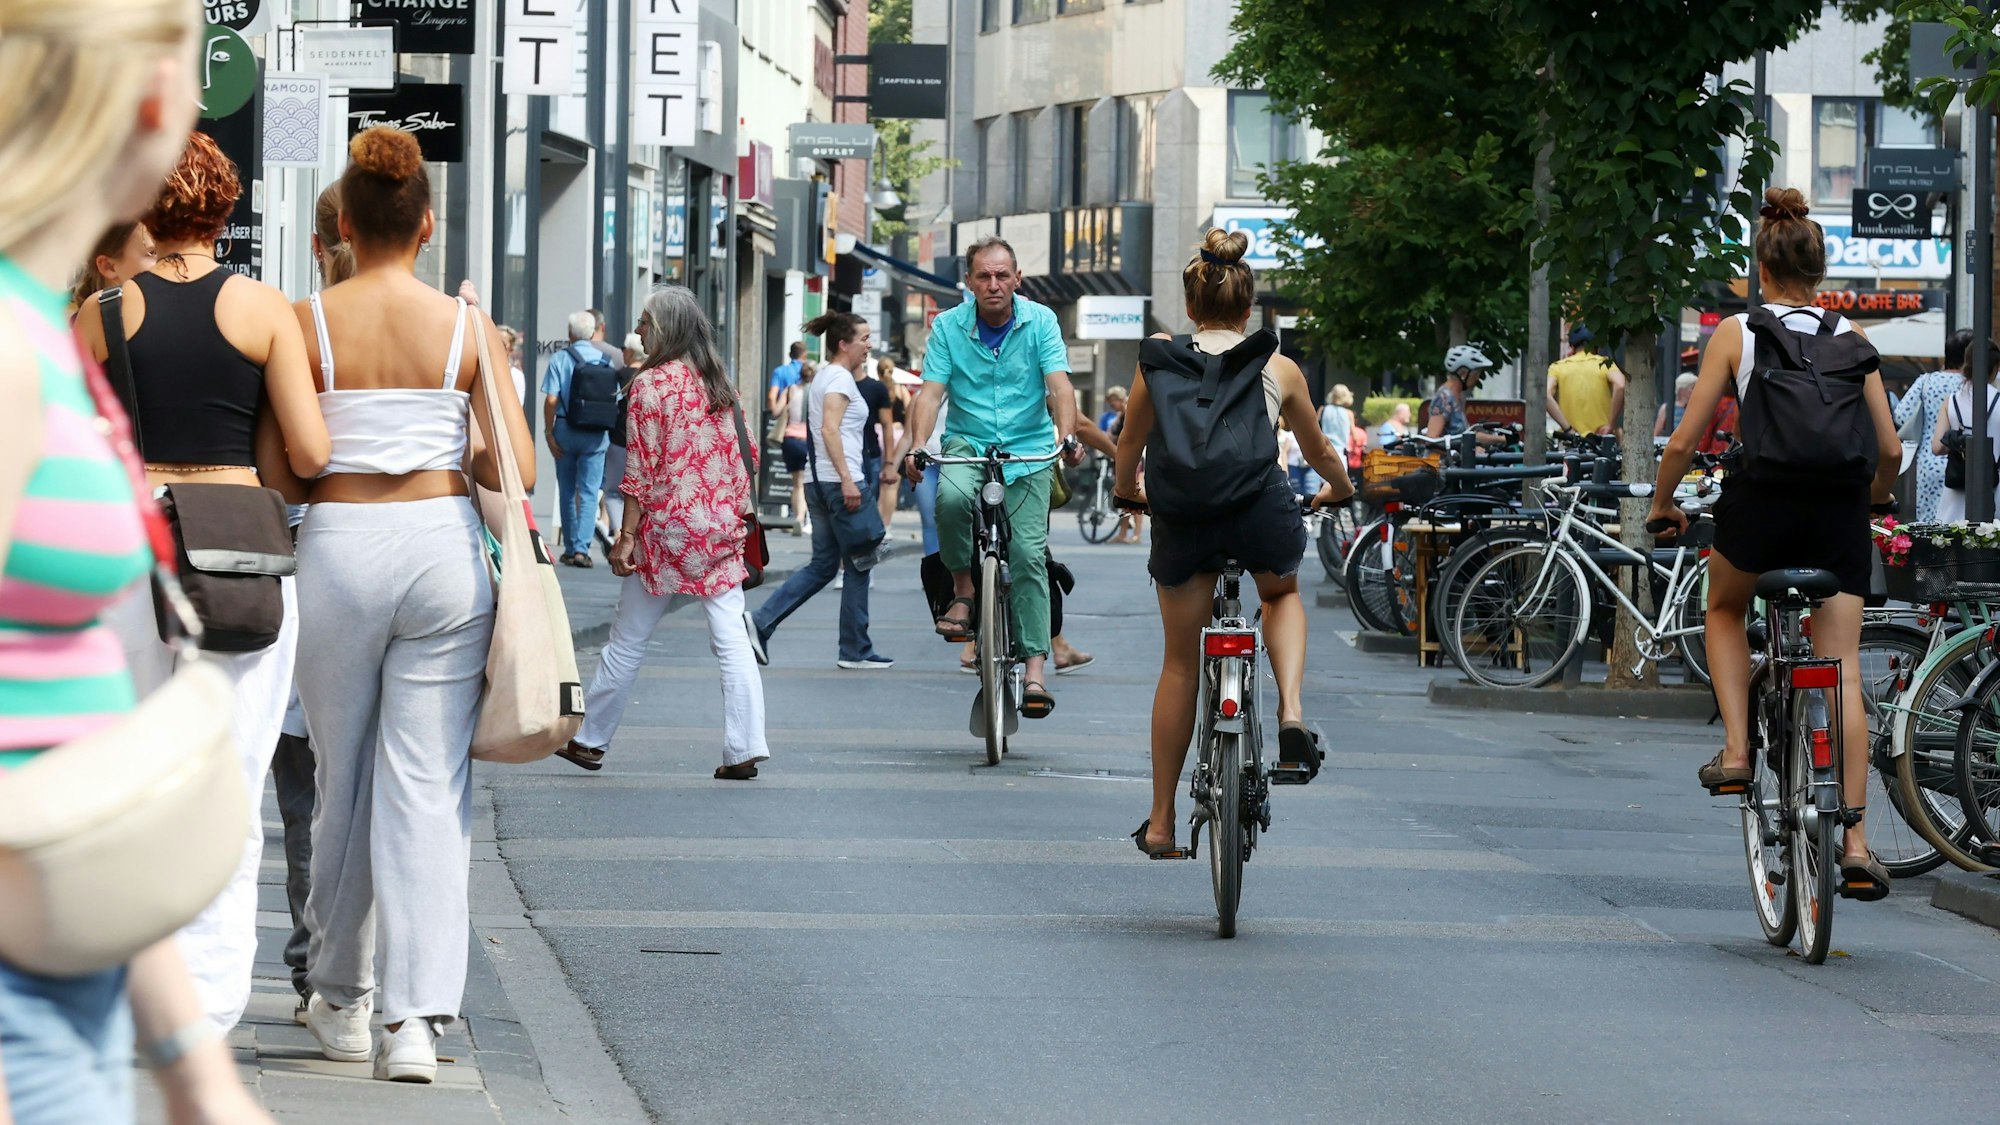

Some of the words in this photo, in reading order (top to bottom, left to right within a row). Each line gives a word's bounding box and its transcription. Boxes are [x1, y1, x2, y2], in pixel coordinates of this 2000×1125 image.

[205, 2, 249, 25] URS
[410, 9, 468, 31] Lingerie
[310, 50, 387, 59] SEIDENFELT
[399, 111, 456, 132] Sabo
[812, 147, 855, 156] OUTLET
[217, 223, 250, 239] GLÄSER
[1857, 222, 1926, 235] hunkemöller
[216, 242, 223, 258] &
[1896, 294, 1921, 309] BAR
[1466, 405, 1520, 416] ANKAUF
